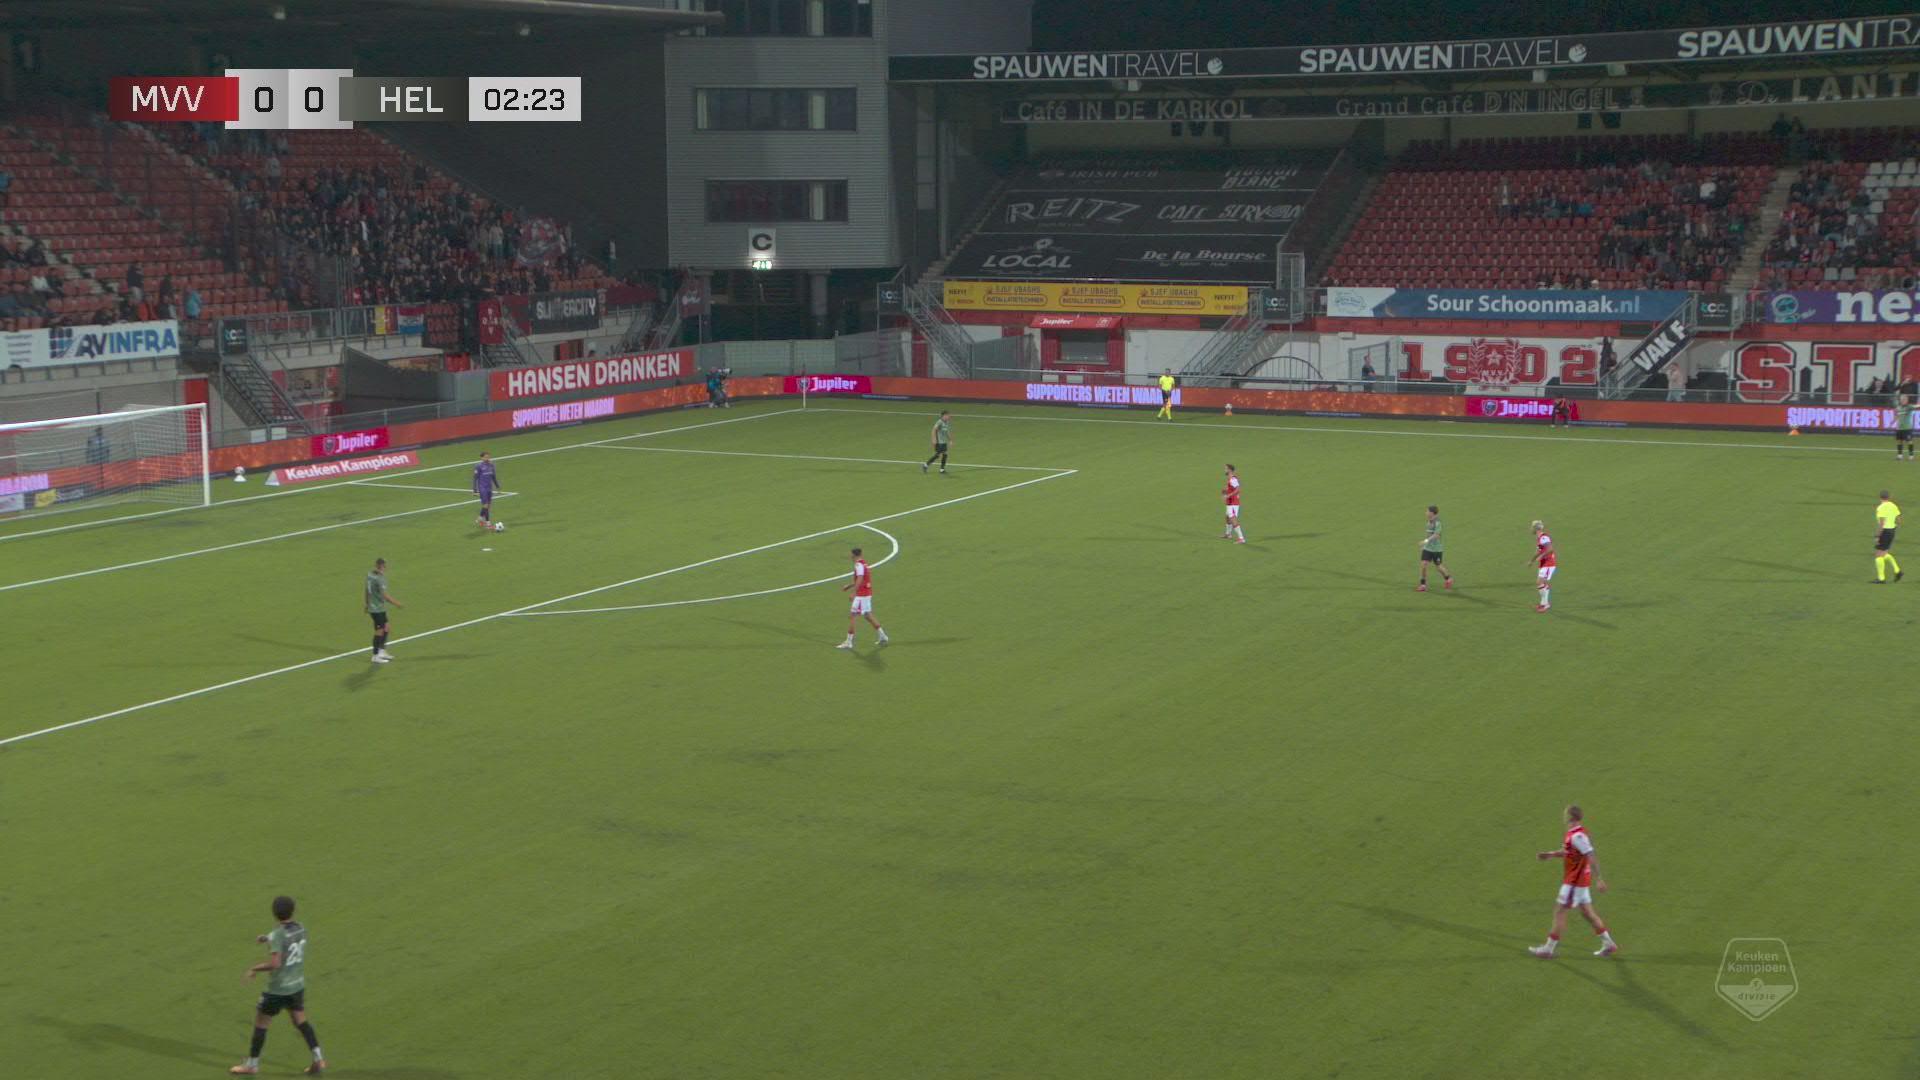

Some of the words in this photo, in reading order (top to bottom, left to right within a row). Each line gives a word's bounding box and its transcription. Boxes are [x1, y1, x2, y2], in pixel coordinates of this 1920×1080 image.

[1791, 71, 1920, 102] LANT
[1018, 101, 1067, 121] Café
[1079, 101, 1102, 121] IN
[1115, 101, 1145, 121] DE
[1157, 99, 1253, 120] KARKOL
[1336, 96, 1409, 116] Grand
[1420, 95, 1474, 114] Café
[751, 232, 773, 251] C
[982, 254, 1073, 268] LOCAL
[1141, 250, 1169, 260] De
[1197, 249, 1267, 261] Bourse
[1427, 294, 1474, 313] Sour
[1478, 293, 1641, 314] Schoonmaak.nl
[1835, 291, 1920, 323] ne
[1633, 332, 1679, 372] VAK
[1670, 319, 1688, 341] F
[508, 364, 590, 397] HANSEN
[595, 353, 680, 385] DRANKEN
[1735, 340, 1920, 405] ST
[810, 376, 858, 391] Jupiler
[1026, 383, 1093, 402] SUPPORTERS
[1094, 385, 1130, 403] WETEN
[1498, 399, 1554, 416] Jupiler
[1787, 407, 1880, 429] SUPPORTERS
[335, 432, 378, 453] Jupiler
[285, 464, 340, 481] Keuken
[340, 454, 410, 472] Kampioen
